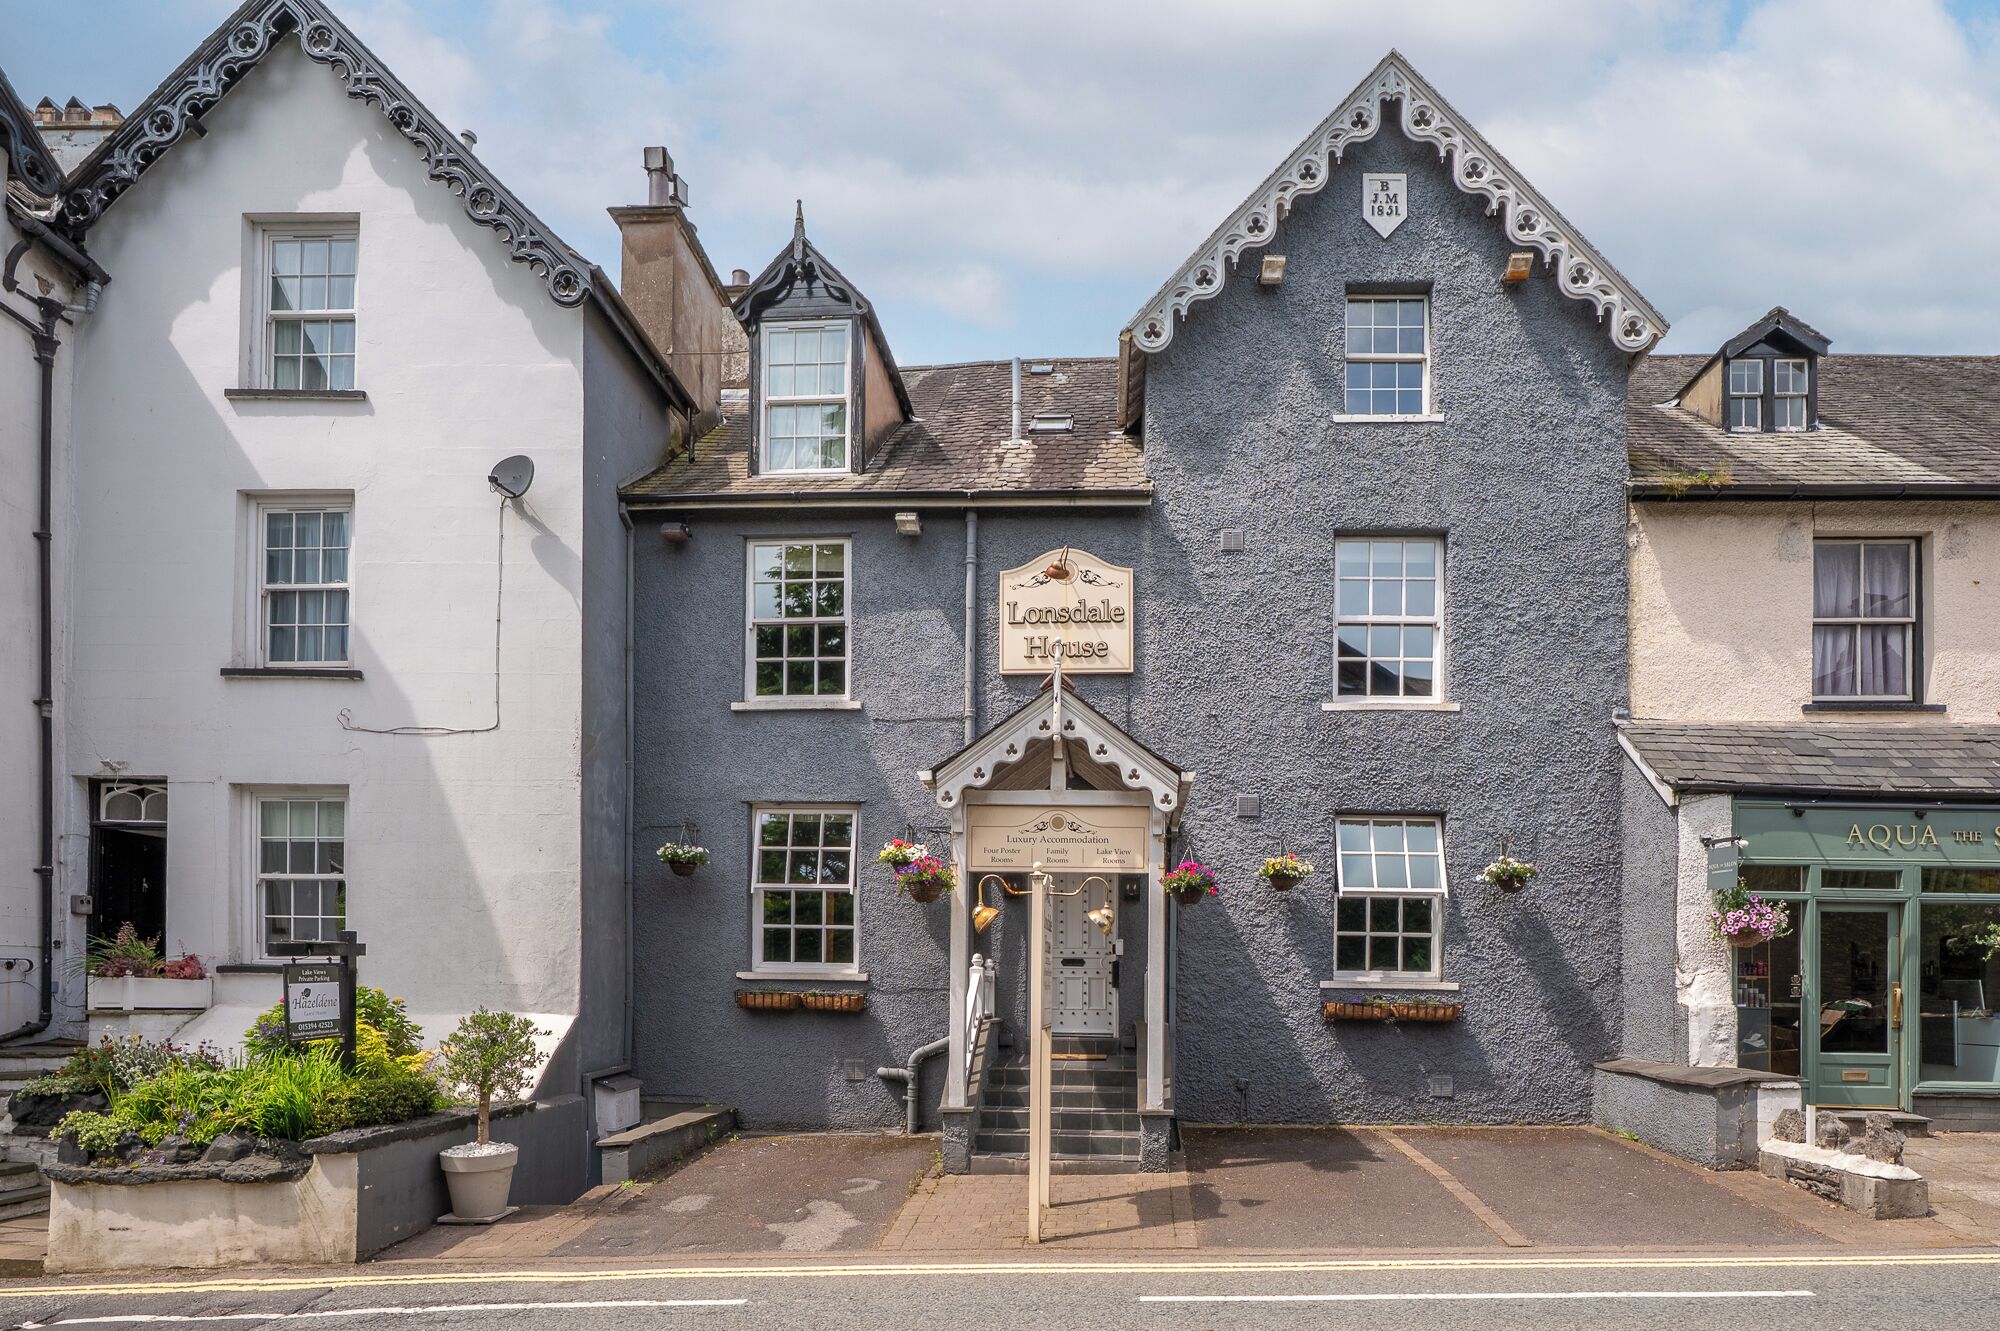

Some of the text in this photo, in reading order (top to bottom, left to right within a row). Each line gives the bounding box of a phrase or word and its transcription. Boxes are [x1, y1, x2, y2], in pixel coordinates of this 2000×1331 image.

[1379, 181, 1389, 192] B
[1006, 598, 1125, 625] Lonsdale
[1023, 635, 1108, 659] House
[1006, 835, 1110, 846] Luxury Accommodation
[1845, 823, 1939, 851] AQUA
[1952, 830, 1983, 842] THE
[1046, 847, 1069, 857] Family
[293, 994, 337, 1009] Hazeldene
